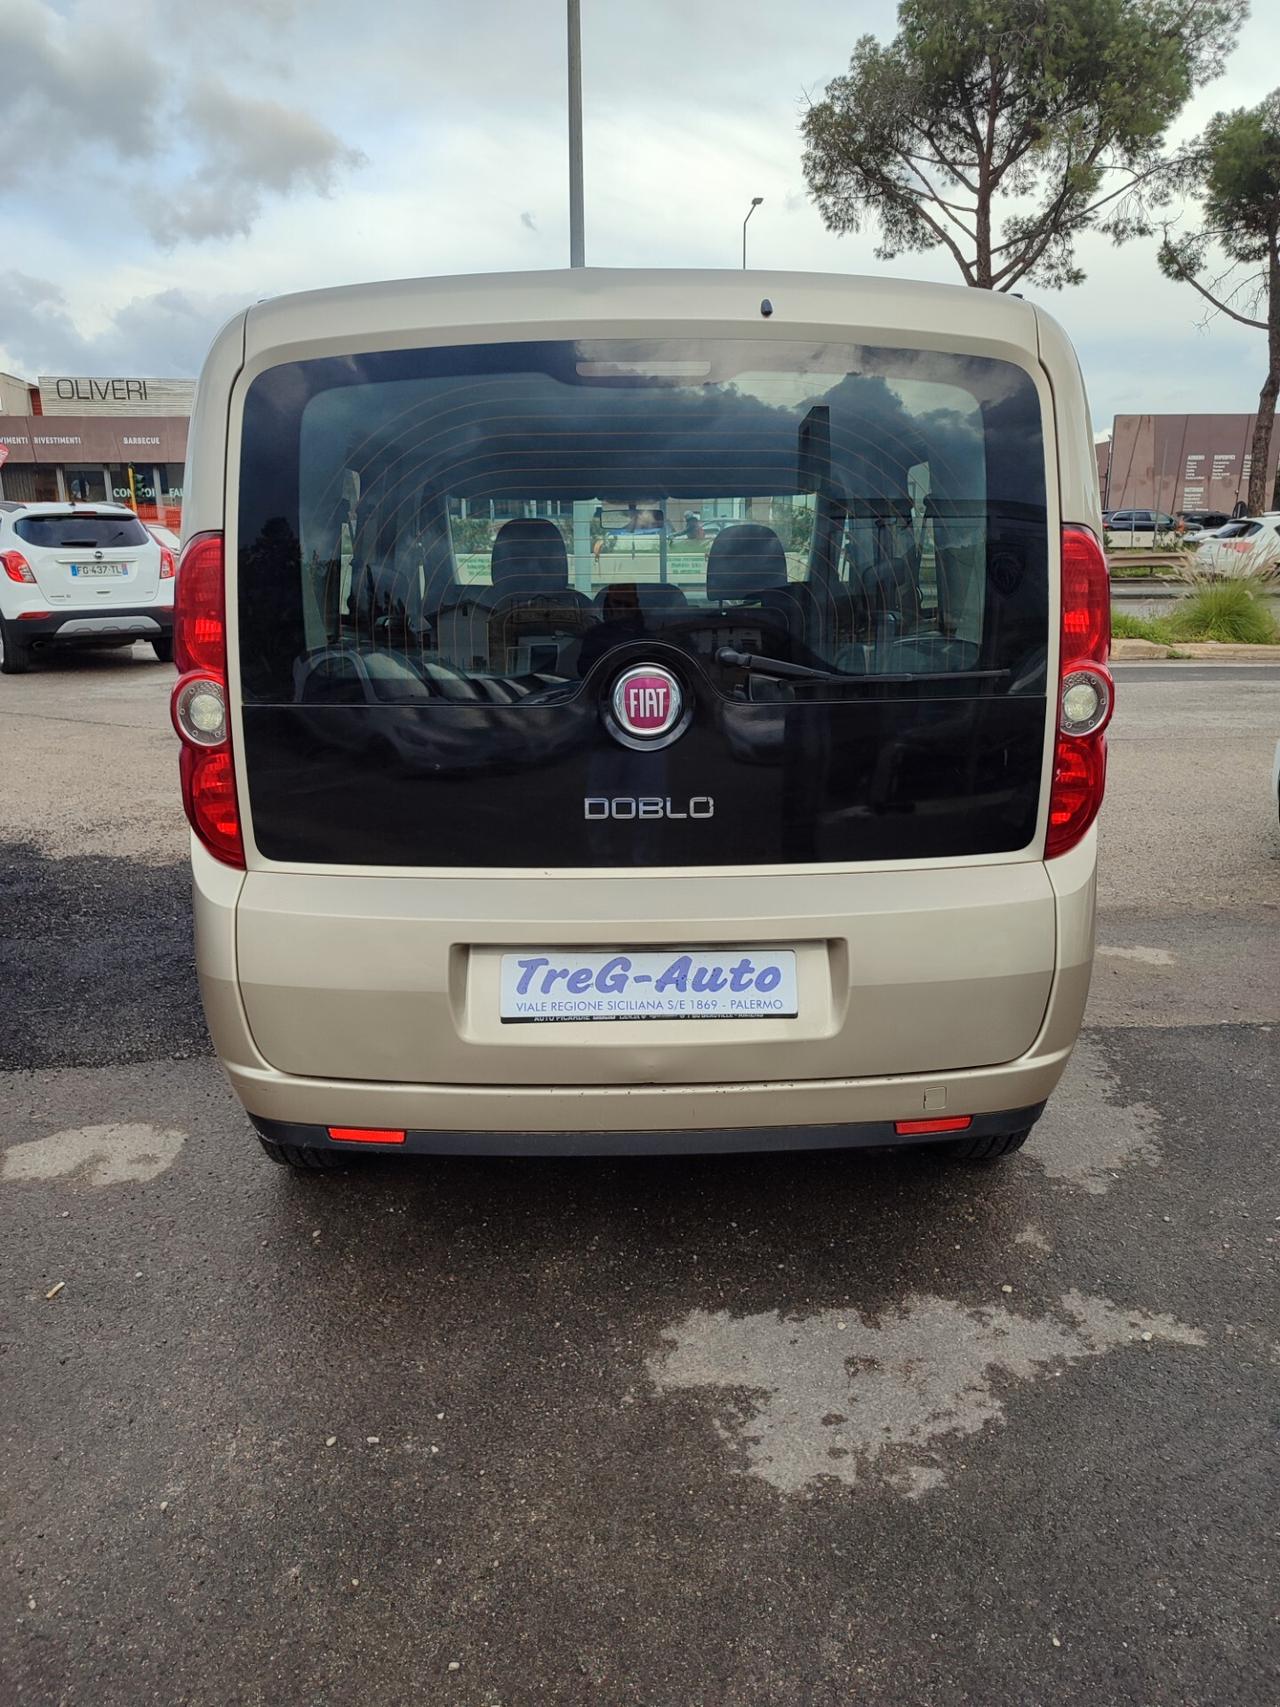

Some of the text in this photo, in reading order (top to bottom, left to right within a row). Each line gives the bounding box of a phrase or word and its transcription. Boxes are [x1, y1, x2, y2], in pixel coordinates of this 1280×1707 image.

[56, 379, 148, 400] OLIVERI
[33, 436, 81, 444] RIVESTIMENTI
[123, 436, 160, 444] BARBECUE
[629, 688, 667, 718] FIAT
[516, 955, 783, 995] TreG-Auto
[516, 1002, 547, 1012] VIALE
[551, 1001, 604, 1012] REGIONE
[607, 1000, 664, 1011] SICILIANA
[667, 999, 685, 1010] S/E
[691, 1000, 718, 1010] 1869
[730, 999, 783, 1010] PALERMO
